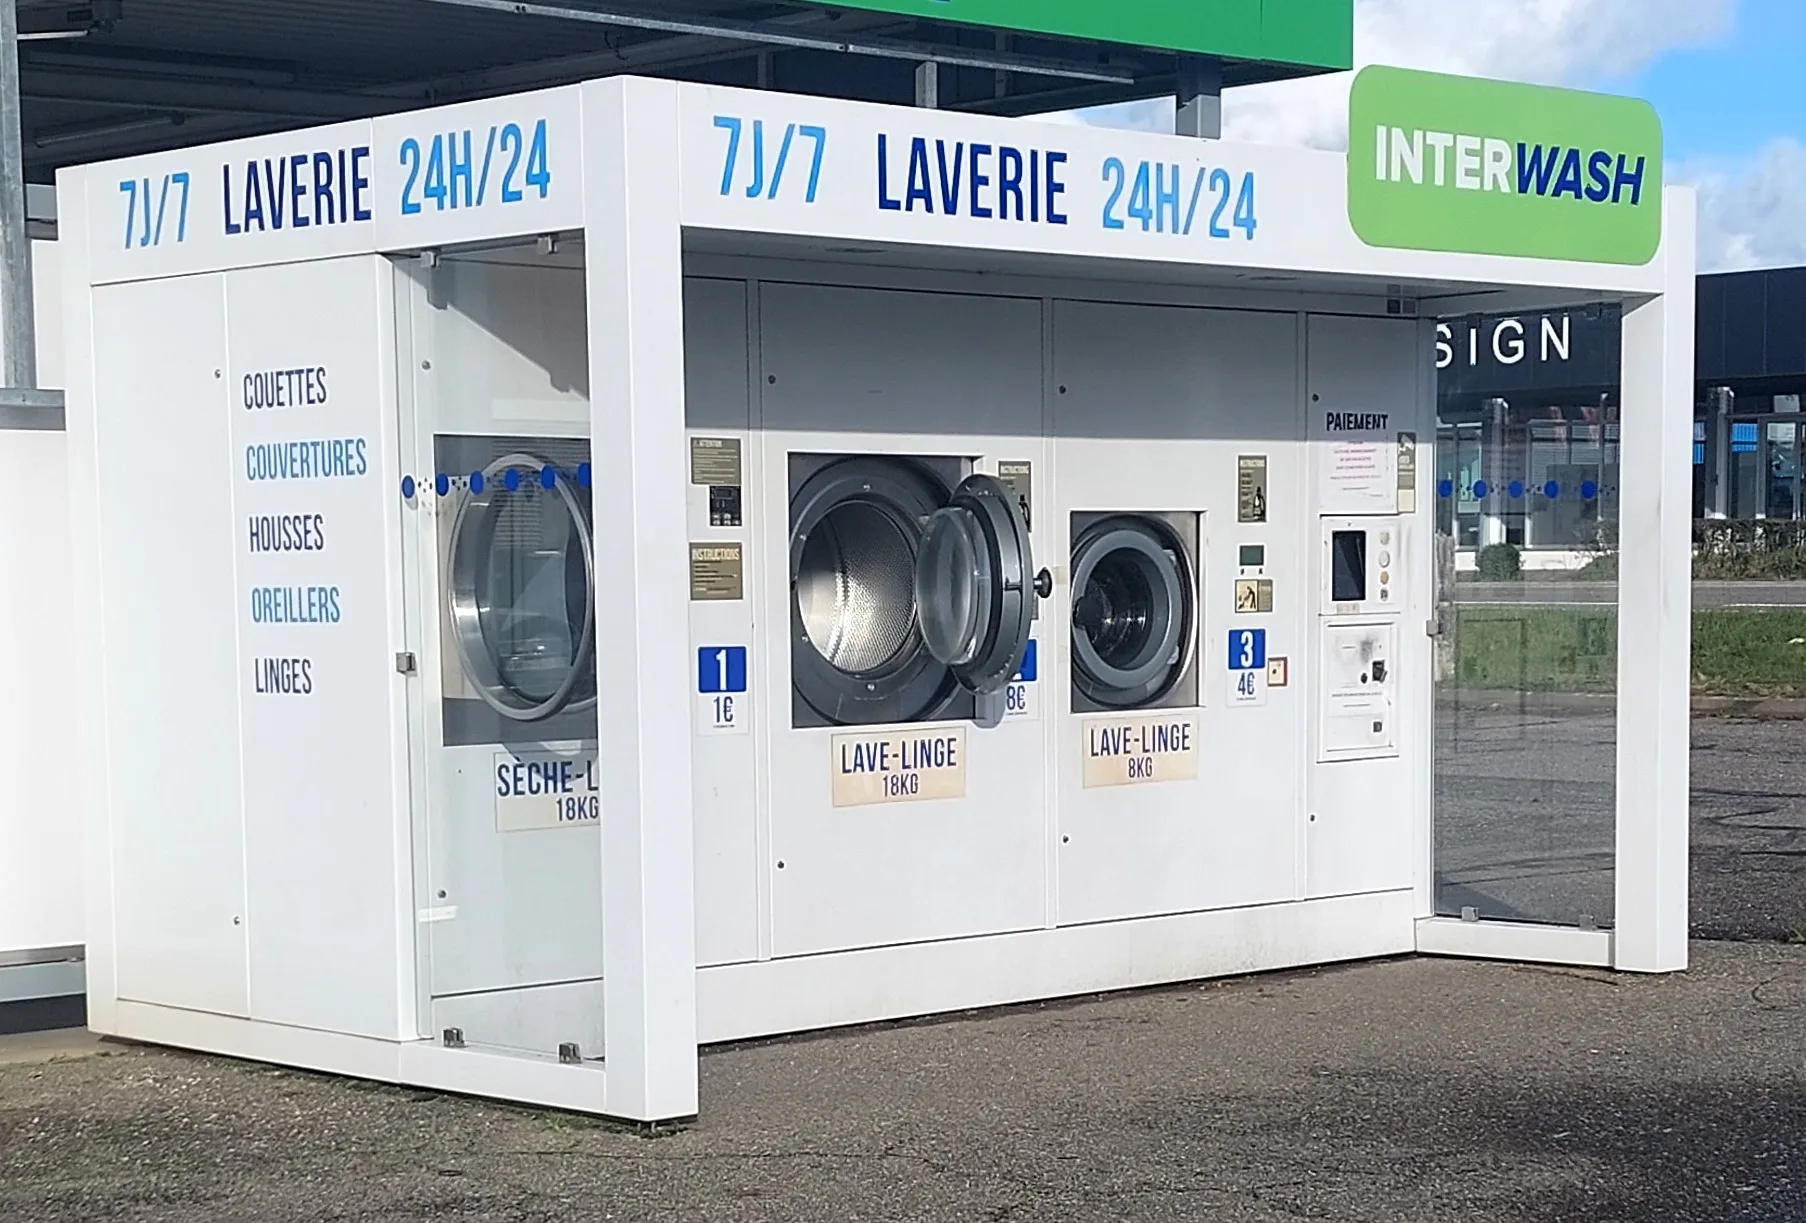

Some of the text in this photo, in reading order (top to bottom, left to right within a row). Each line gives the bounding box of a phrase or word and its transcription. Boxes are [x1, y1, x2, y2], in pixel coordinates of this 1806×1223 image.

[119, 118, 550, 249] 7J/7 LAVERIE 24H/24
[713, 115, 1257, 241] 7J/7 LAVERIE 24H/24
[1375, 124, 1646, 206] INTERWASH
[243, 367, 327, 410] COUETTES
[1326, 412, 1388, 431] PAIEMENT
[246, 438, 367, 481] COUVERTURES
[249, 514, 325, 553] HOUSSES
[251, 586, 341, 623] OREILLERS
[1240, 631, 1254, 668] 3
[255, 657, 312, 694] LINGES
[715, 649, 727, 691] 1
[1238, 672, 1255, 695] 4€
[713, 696, 734, 723] 1€
[1006, 685, 1026, 710] 8€
[842, 738, 957, 774] LAVE-LINGE
[1090, 723, 1191, 757] LAVE-LINGE
[497, 756, 599, 797] SÈCHE-L
[883, 773, 919, 797] 18KG
[1128, 757, 1153, 778] 8KG
[556, 796, 599, 822] 18KG
